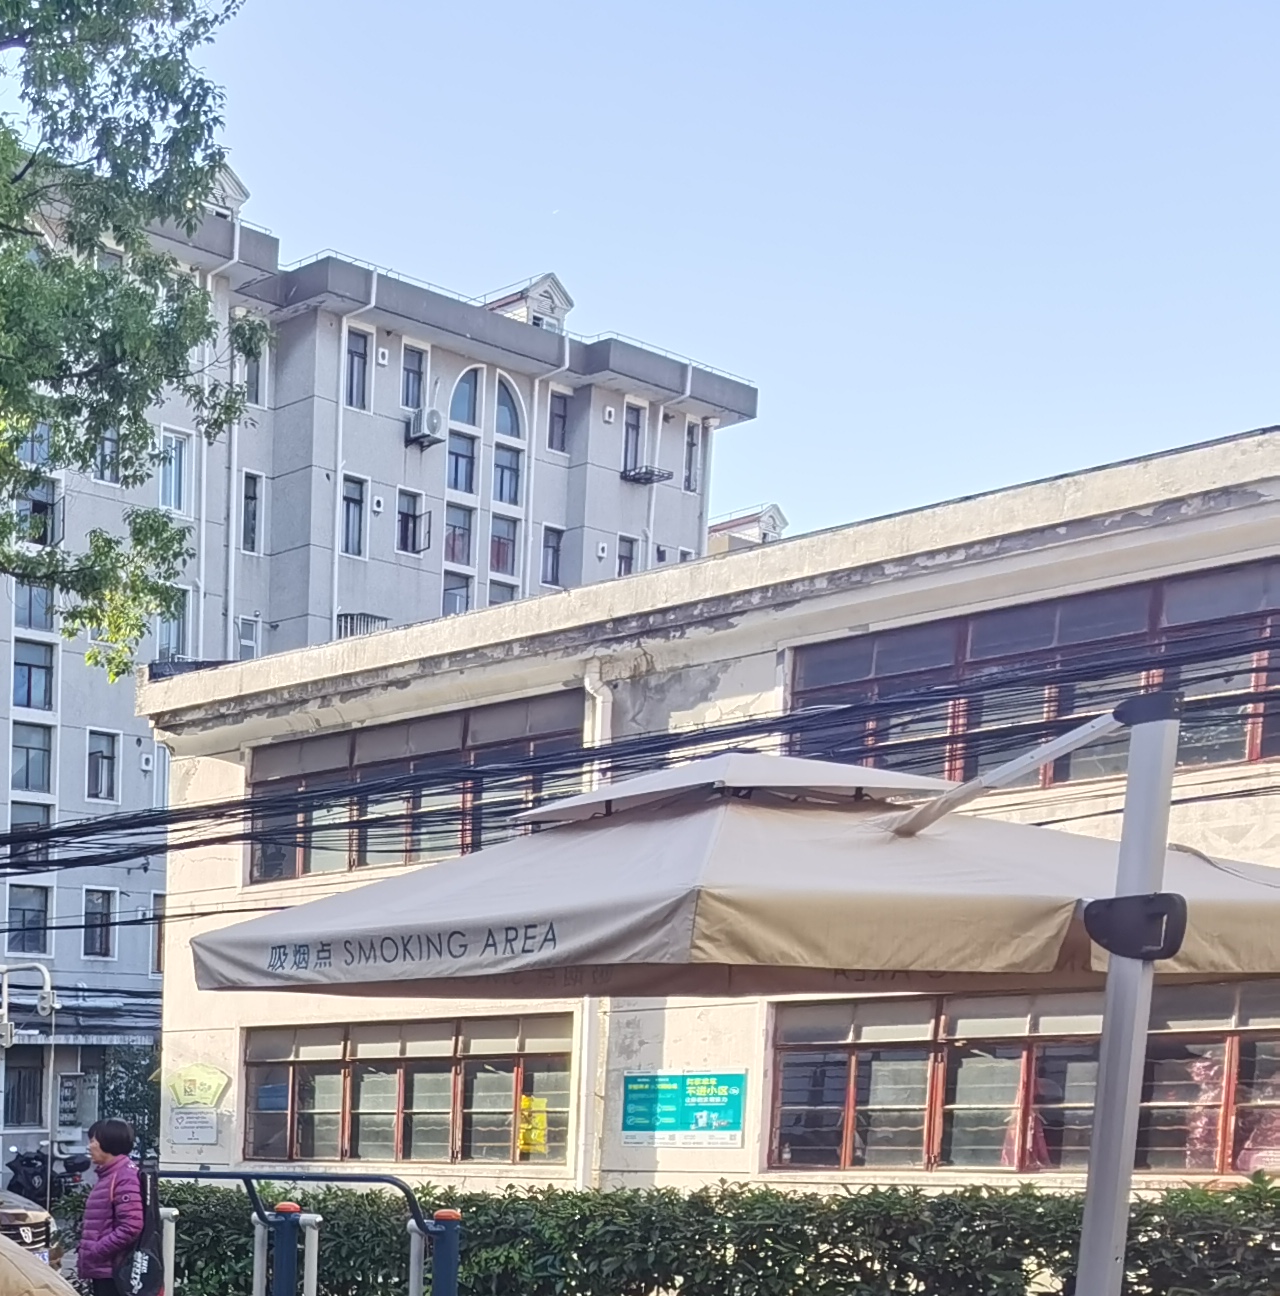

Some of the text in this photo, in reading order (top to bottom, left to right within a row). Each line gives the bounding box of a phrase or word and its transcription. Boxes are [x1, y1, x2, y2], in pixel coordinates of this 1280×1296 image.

[267, 921, 558, 971] 吸烟点 SMOKING AREA
